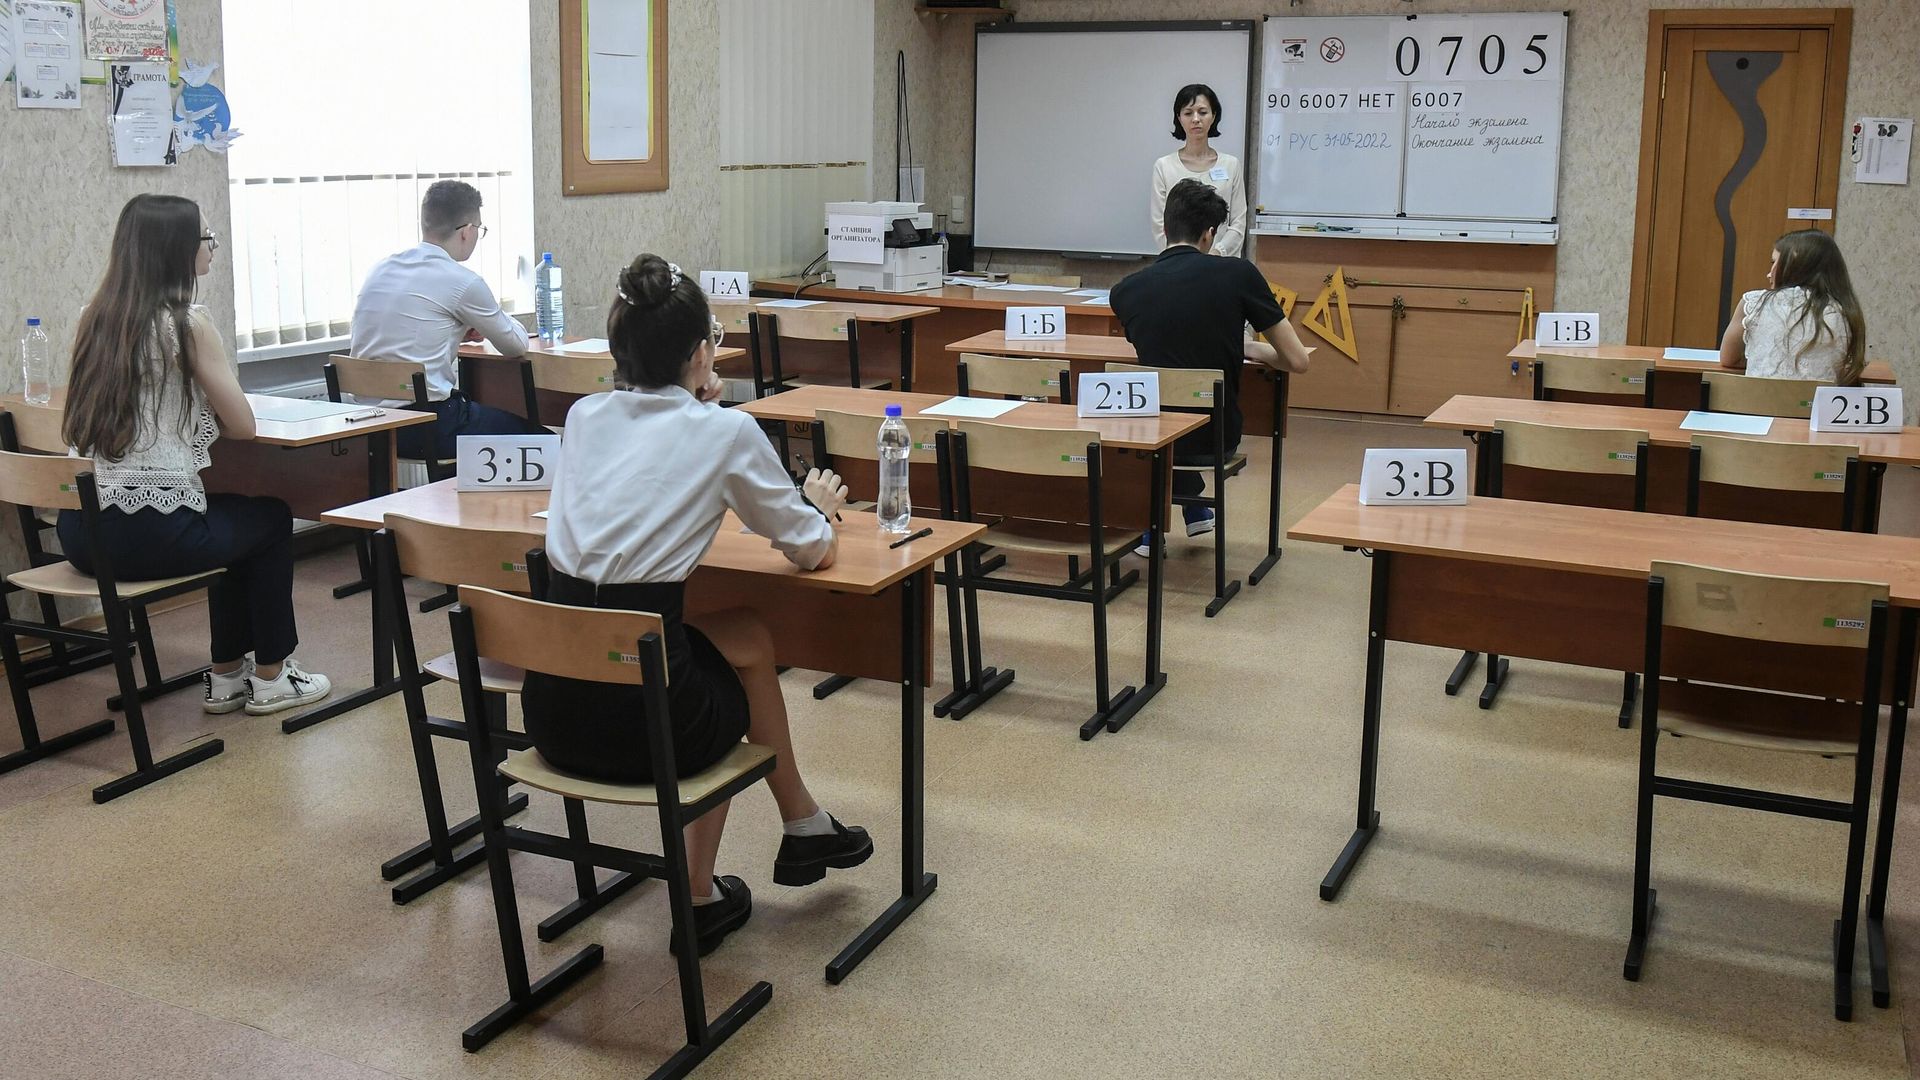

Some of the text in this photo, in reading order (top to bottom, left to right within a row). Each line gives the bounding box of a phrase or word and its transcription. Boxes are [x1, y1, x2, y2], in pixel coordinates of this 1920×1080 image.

[133, 73, 167, 83] ГРАМОТА
[1267, 93, 1396, 109] 90 6007 НЕТ
[1411, 92, 1463, 108] 6007
[1411, 113, 1529, 135] Начало экзамена
[1266, 134, 1281, 147] 01
[1289, 132, 1319, 151] РУС
[1411, 134, 1545, 154] Окончание экзамена
[830, 234, 881, 243] ОРГАНИЗАТОРА
[840, 226, 872, 234] СТАНЦИЯ
[709, 277, 742, 295] 1:А
[1019, 313, 1056, 335] 1:Б
[1553, 320, 1591, 341] 1:В
[1095, 381, 1147, 410] 2:Б
[1831, 395, 1890, 425] 2:В
[477, 446, 545, 483] 3:Б
[1385, 460, 1455, 497] 3:В
[1836, 619, 1865, 630] 1135292
